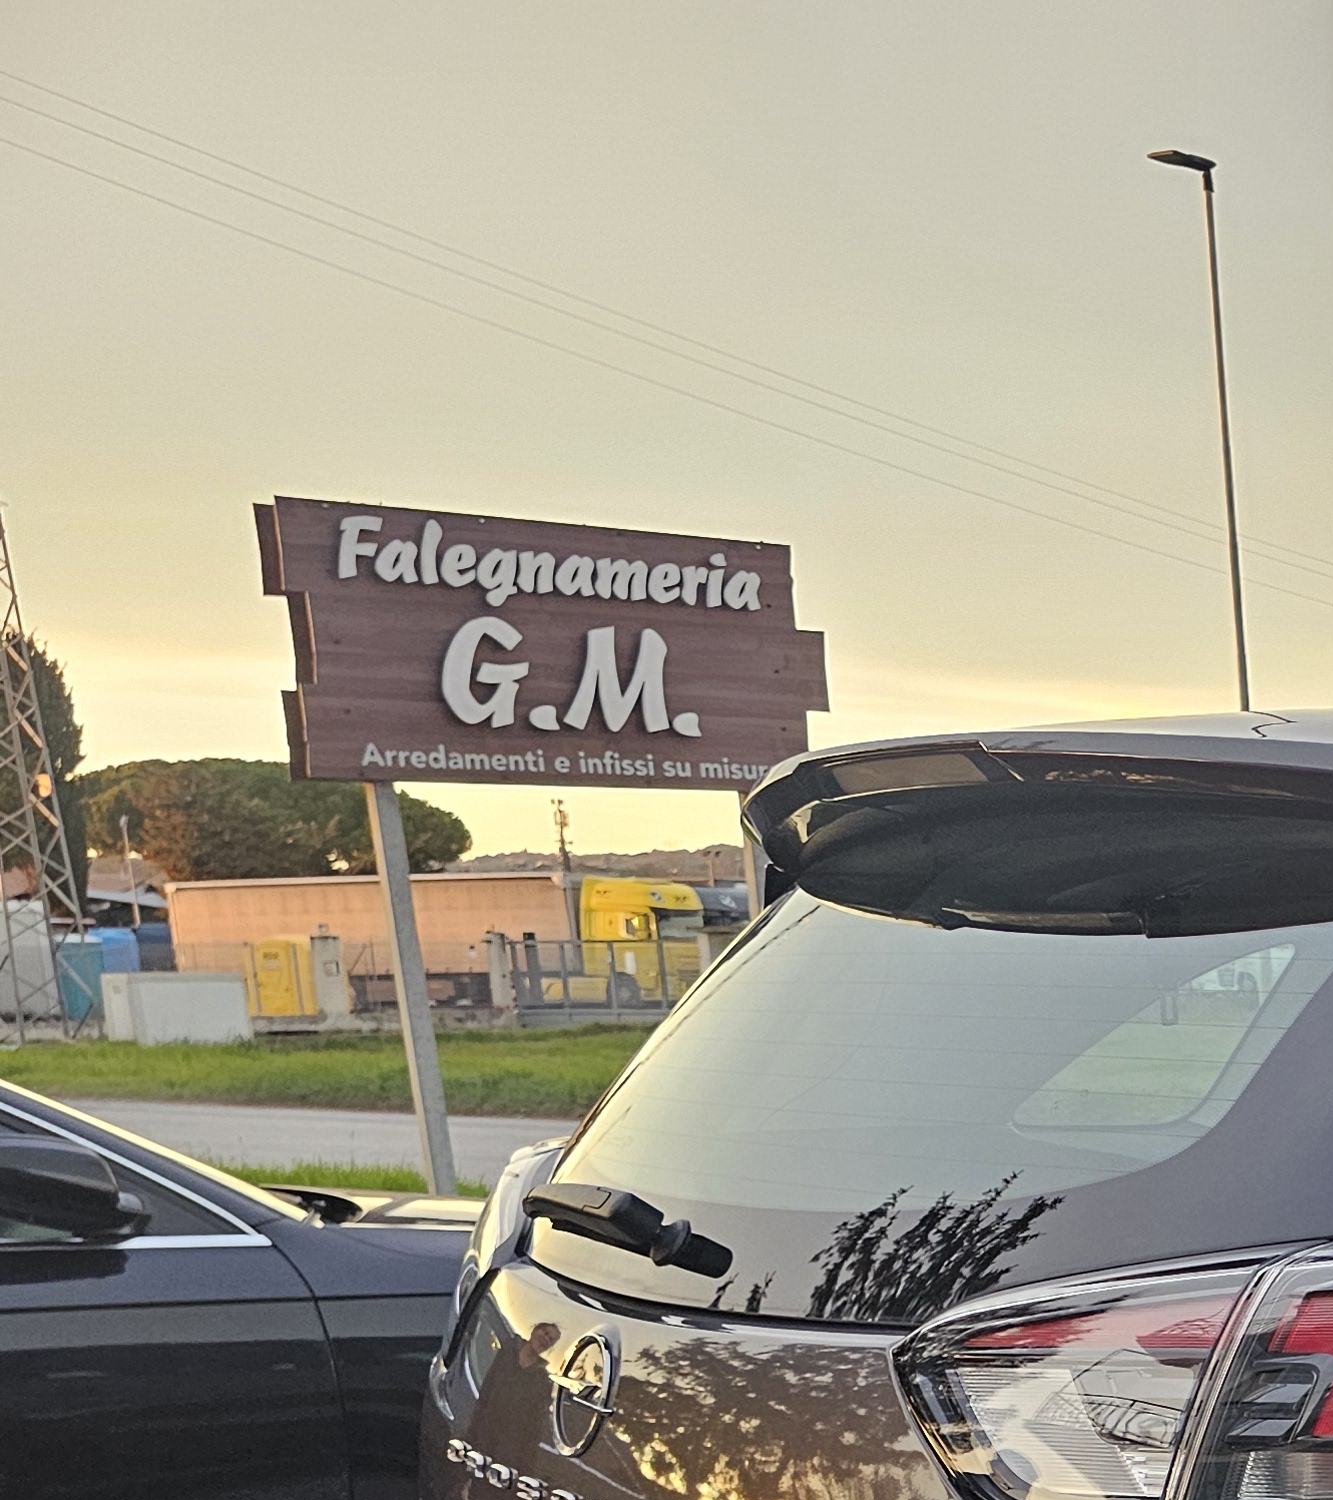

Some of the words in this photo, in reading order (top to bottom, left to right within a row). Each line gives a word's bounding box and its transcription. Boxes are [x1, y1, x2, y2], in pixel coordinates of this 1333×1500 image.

[338, 515, 762, 611] Falegnameria
[442, 616, 702, 737] G.M.
[361, 742, 546, 773] Arredamenti
[554, 755, 571, 773] e
[578, 751, 655, 777] infissi
[662, 759, 692, 777] su
[700, 757, 768, 780] misur
